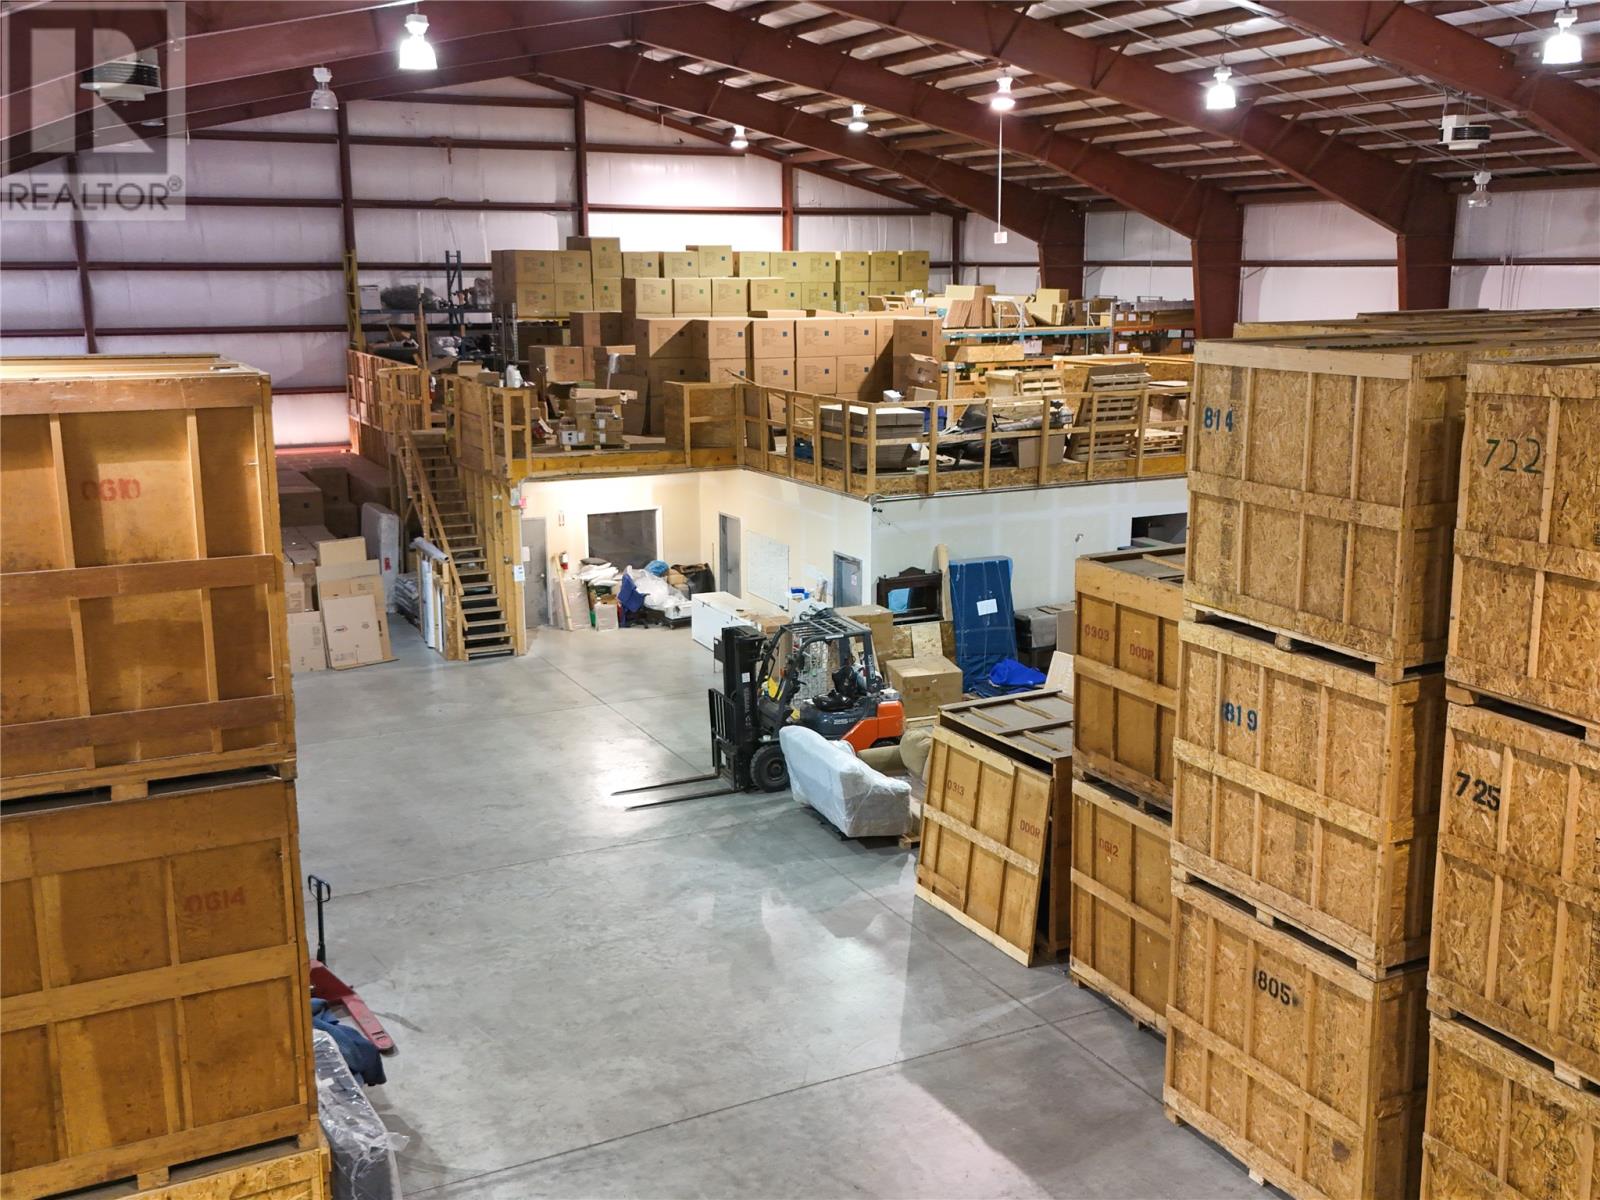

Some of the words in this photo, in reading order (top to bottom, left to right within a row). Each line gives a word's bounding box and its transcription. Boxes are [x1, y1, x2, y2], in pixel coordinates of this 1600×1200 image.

[1203, 406, 1233, 433] 814
[1484, 438, 1542, 474] 722
[1224, 702, 1258, 732] 819
[1456, 770, 1501, 811] 725
[1258, 970, 1291, 1006] 805
